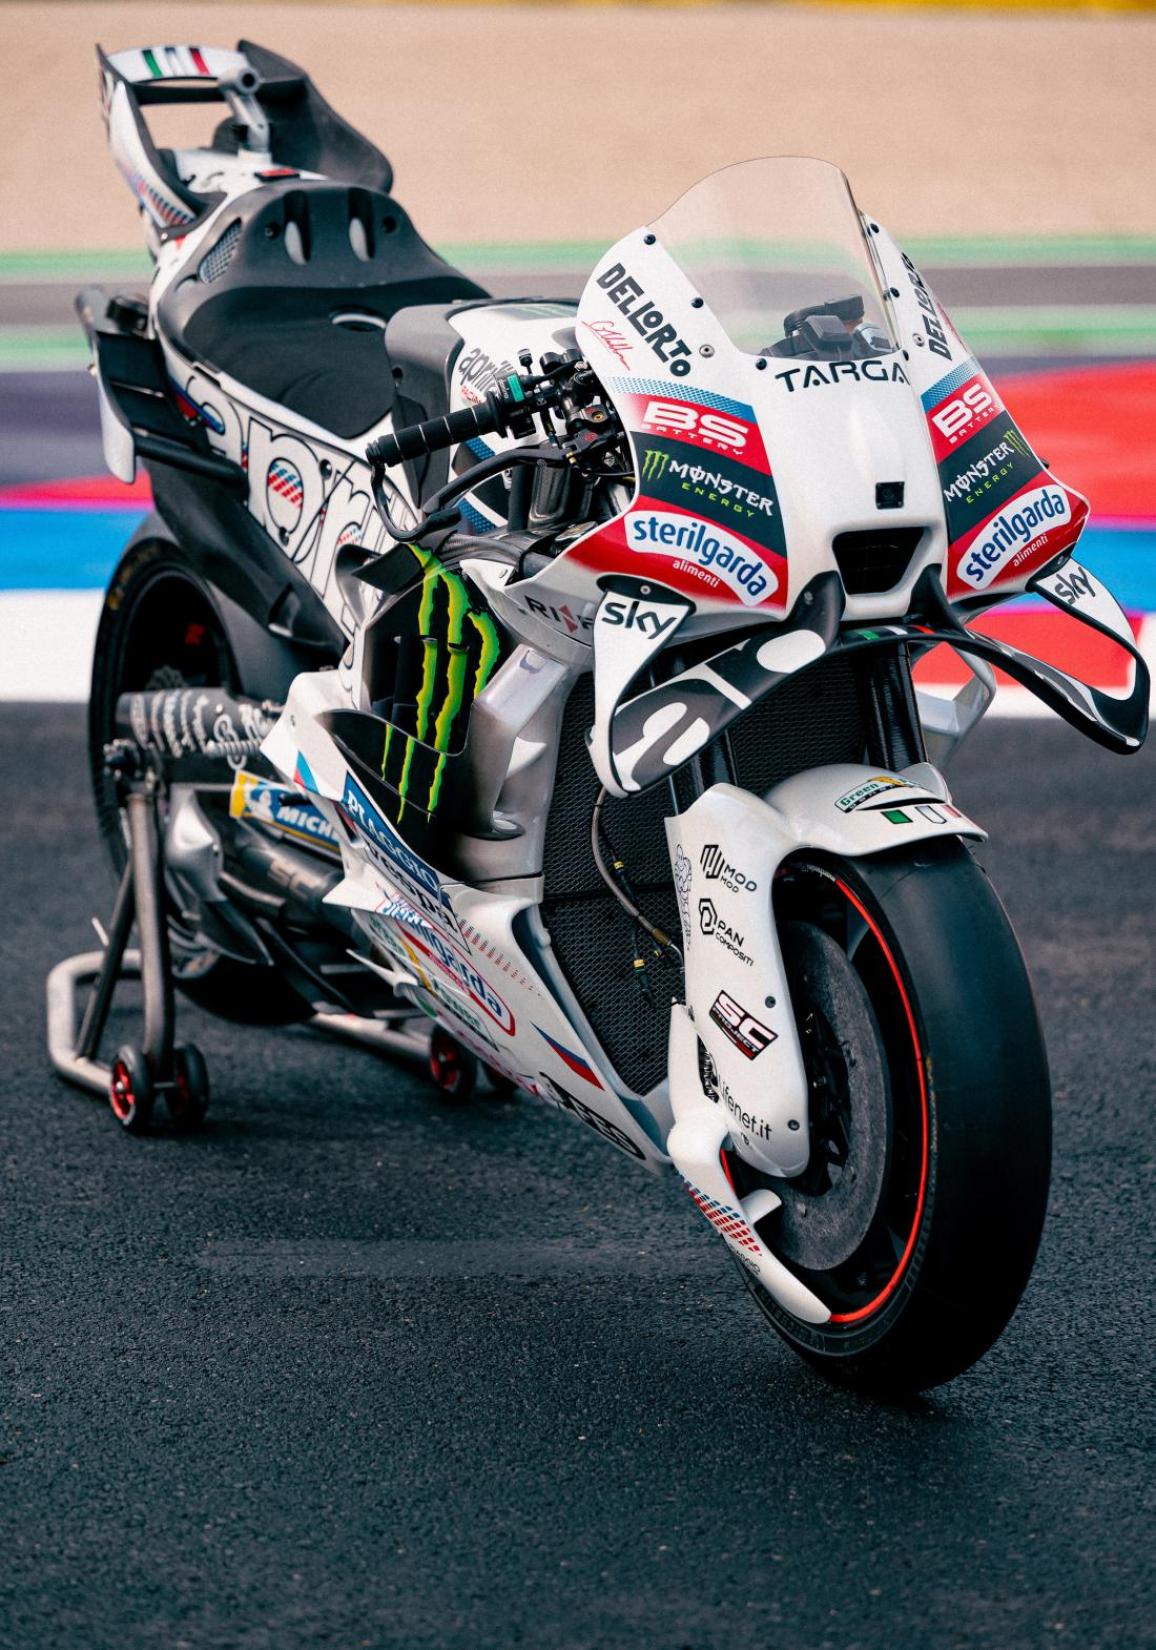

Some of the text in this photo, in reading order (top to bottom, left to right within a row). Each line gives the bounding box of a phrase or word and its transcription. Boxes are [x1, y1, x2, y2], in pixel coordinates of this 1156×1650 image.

[775, 360, 911, 392] TARGA
[642, 401, 749, 447] BS
[932, 384, 992, 437] BS
[948, 402, 998, 444] BATTER
[681, 482, 755, 517] ENERGY
[966, 462, 1014, 504] ENERGY
[966, 489, 1065, 582] sterilgarda
[1012, 534, 1049, 567] alimenti
[633, 517, 767, 596] sterilgarda
[673, 560, 720, 588] alimenti
[1055, 566, 1096, 604] sky
[602, 601, 677, 639] sky
[840, 782, 880, 806] Green
[720, 875, 740, 894] MOD
[723, 863, 757, 892] MOD
[717, 920, 744, 947] PAN
[715, 992, 777, 1050] SC
